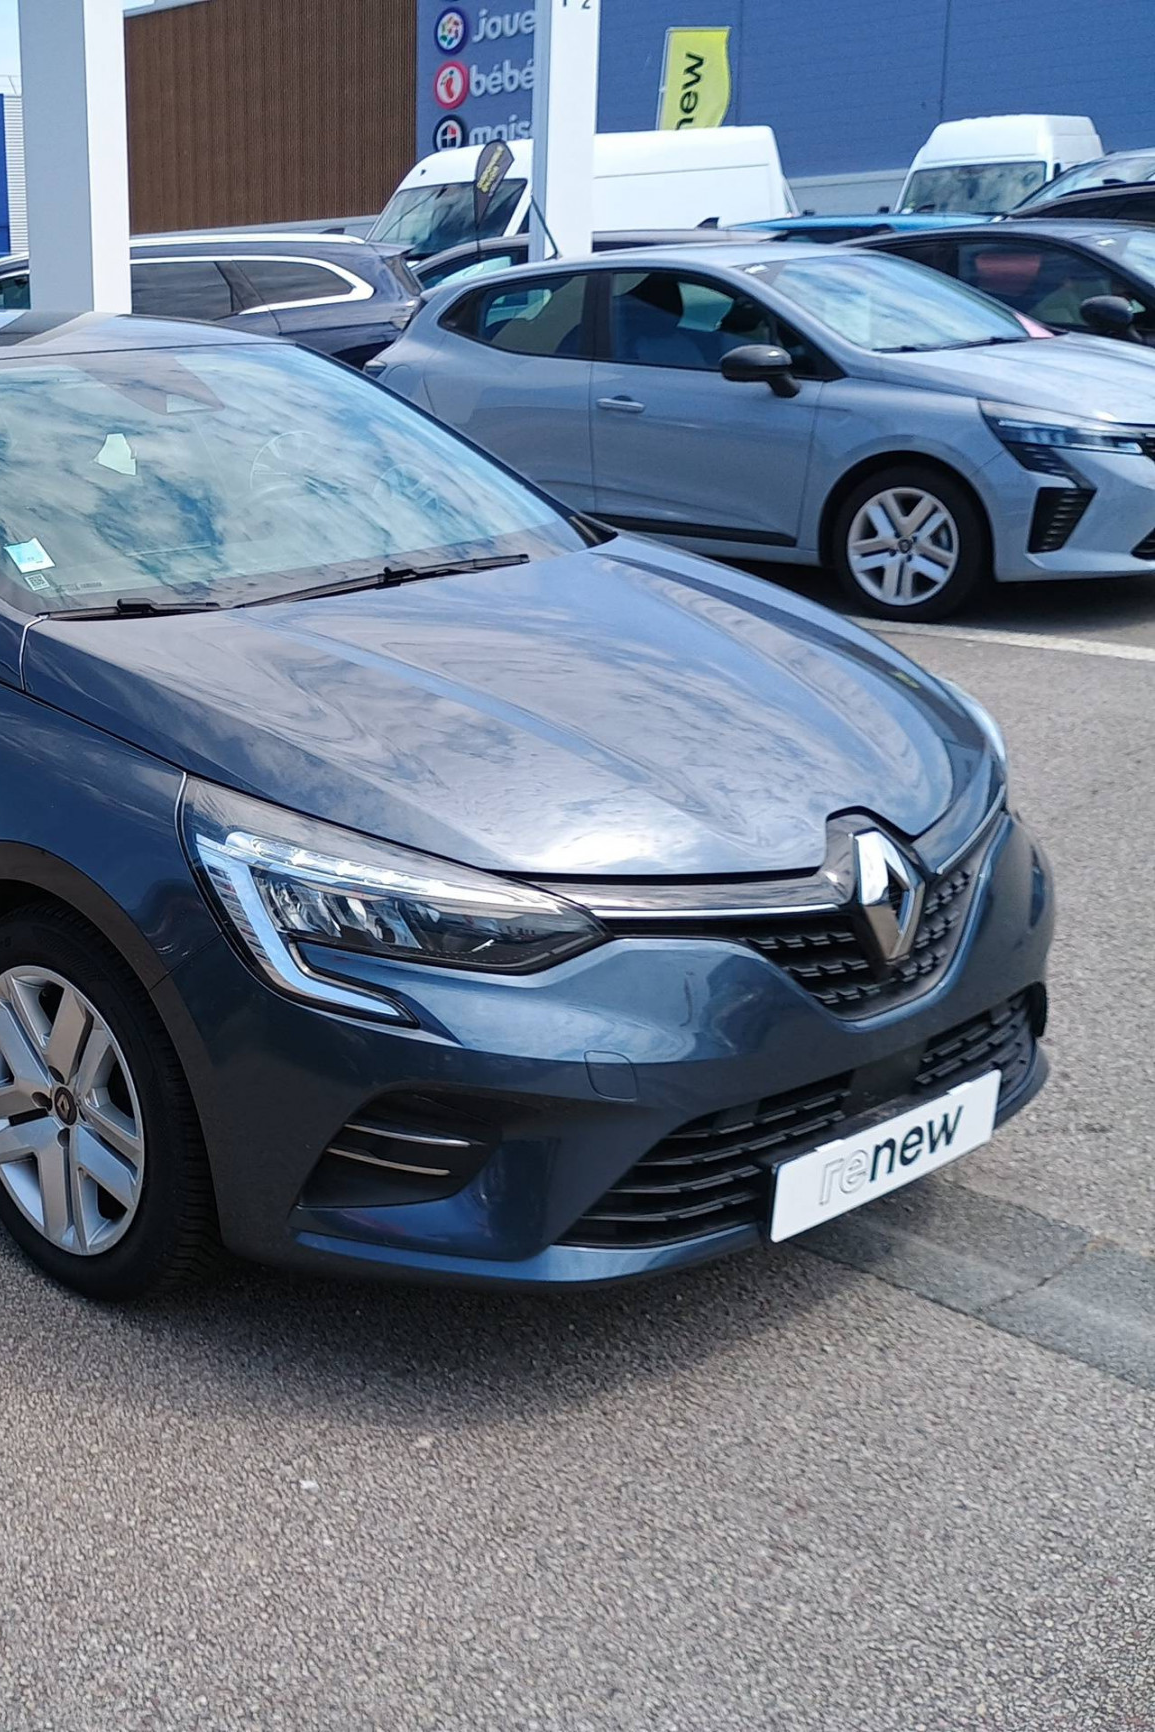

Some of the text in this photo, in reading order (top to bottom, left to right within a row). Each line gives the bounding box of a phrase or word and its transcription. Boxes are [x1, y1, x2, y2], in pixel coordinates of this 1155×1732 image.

[471, 8, 535, 44] joue
[468, 58, 535, 98] bébé
[468, 113, 534, 146] mais
[818, 1104, 964, 1206] renew
